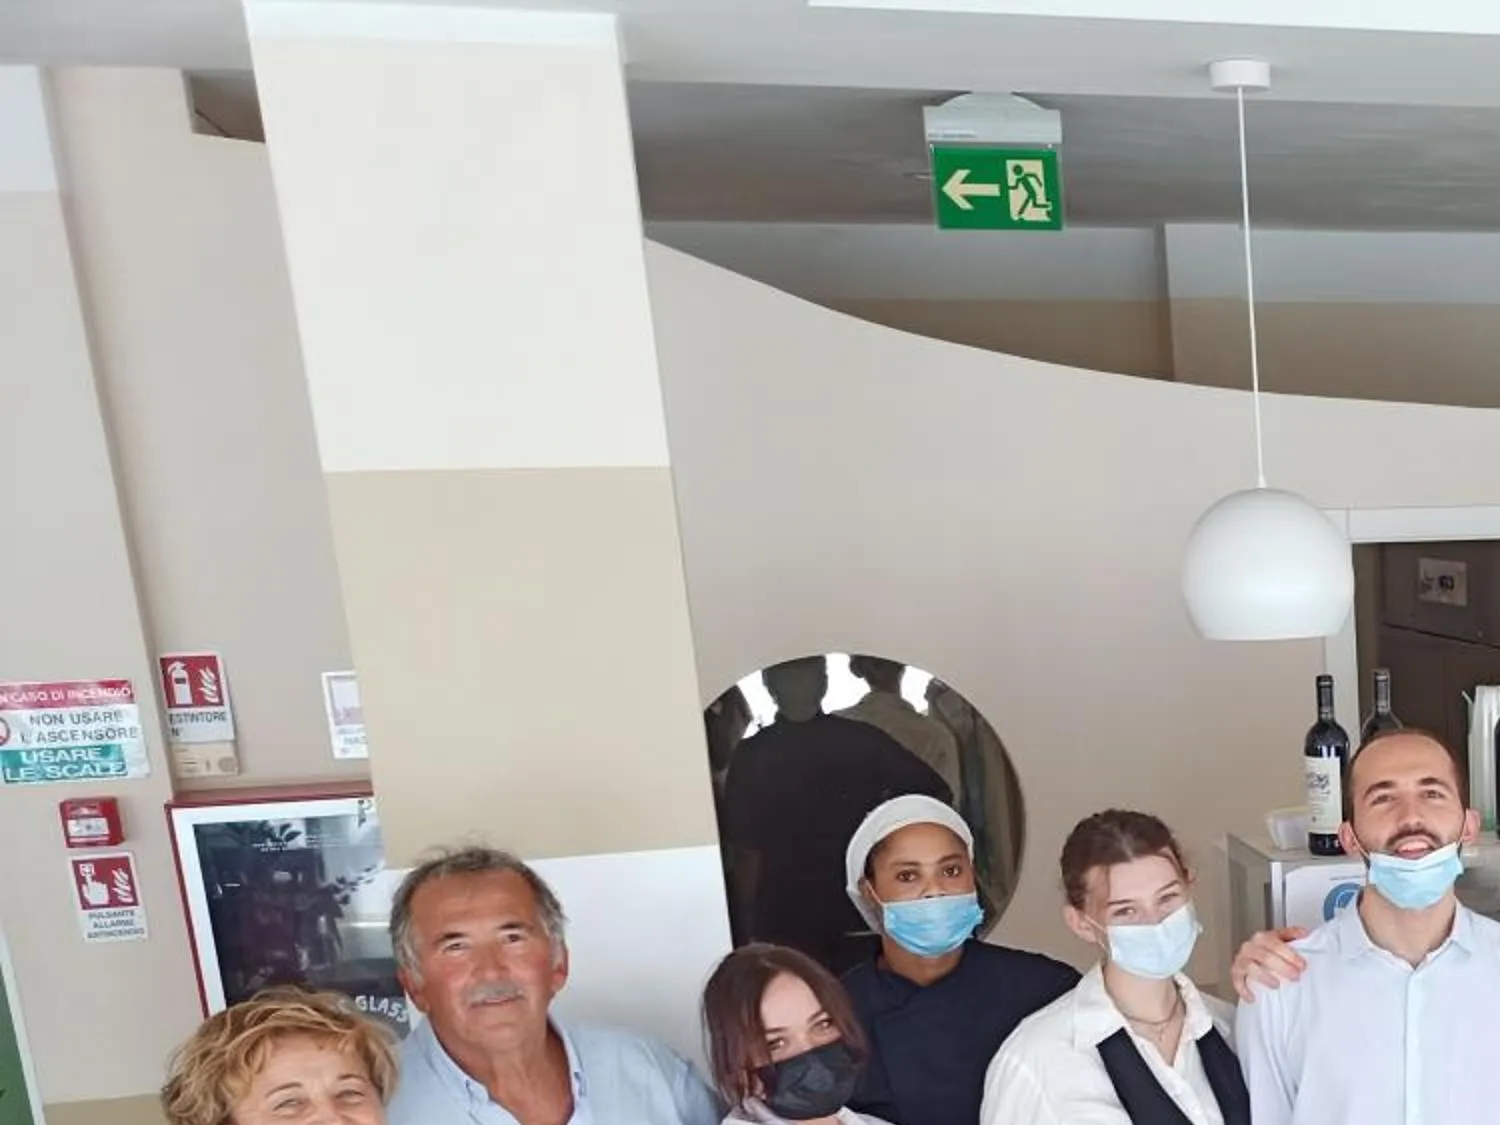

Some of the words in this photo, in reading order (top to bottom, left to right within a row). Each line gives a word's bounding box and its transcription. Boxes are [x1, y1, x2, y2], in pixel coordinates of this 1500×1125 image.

[11, 690, 48, 702] CASO
[67, 687, 131, 700] INCENDIO
[30, 713, 64, 726] NON
[69, 710, 122, 725] USARE
[168, 711, 226, 724] ESTINTORE
[20, 747, 102, 764] USARE
[5, 766, 37, 781] LE
[44, 761, 126, 779] SCALE
